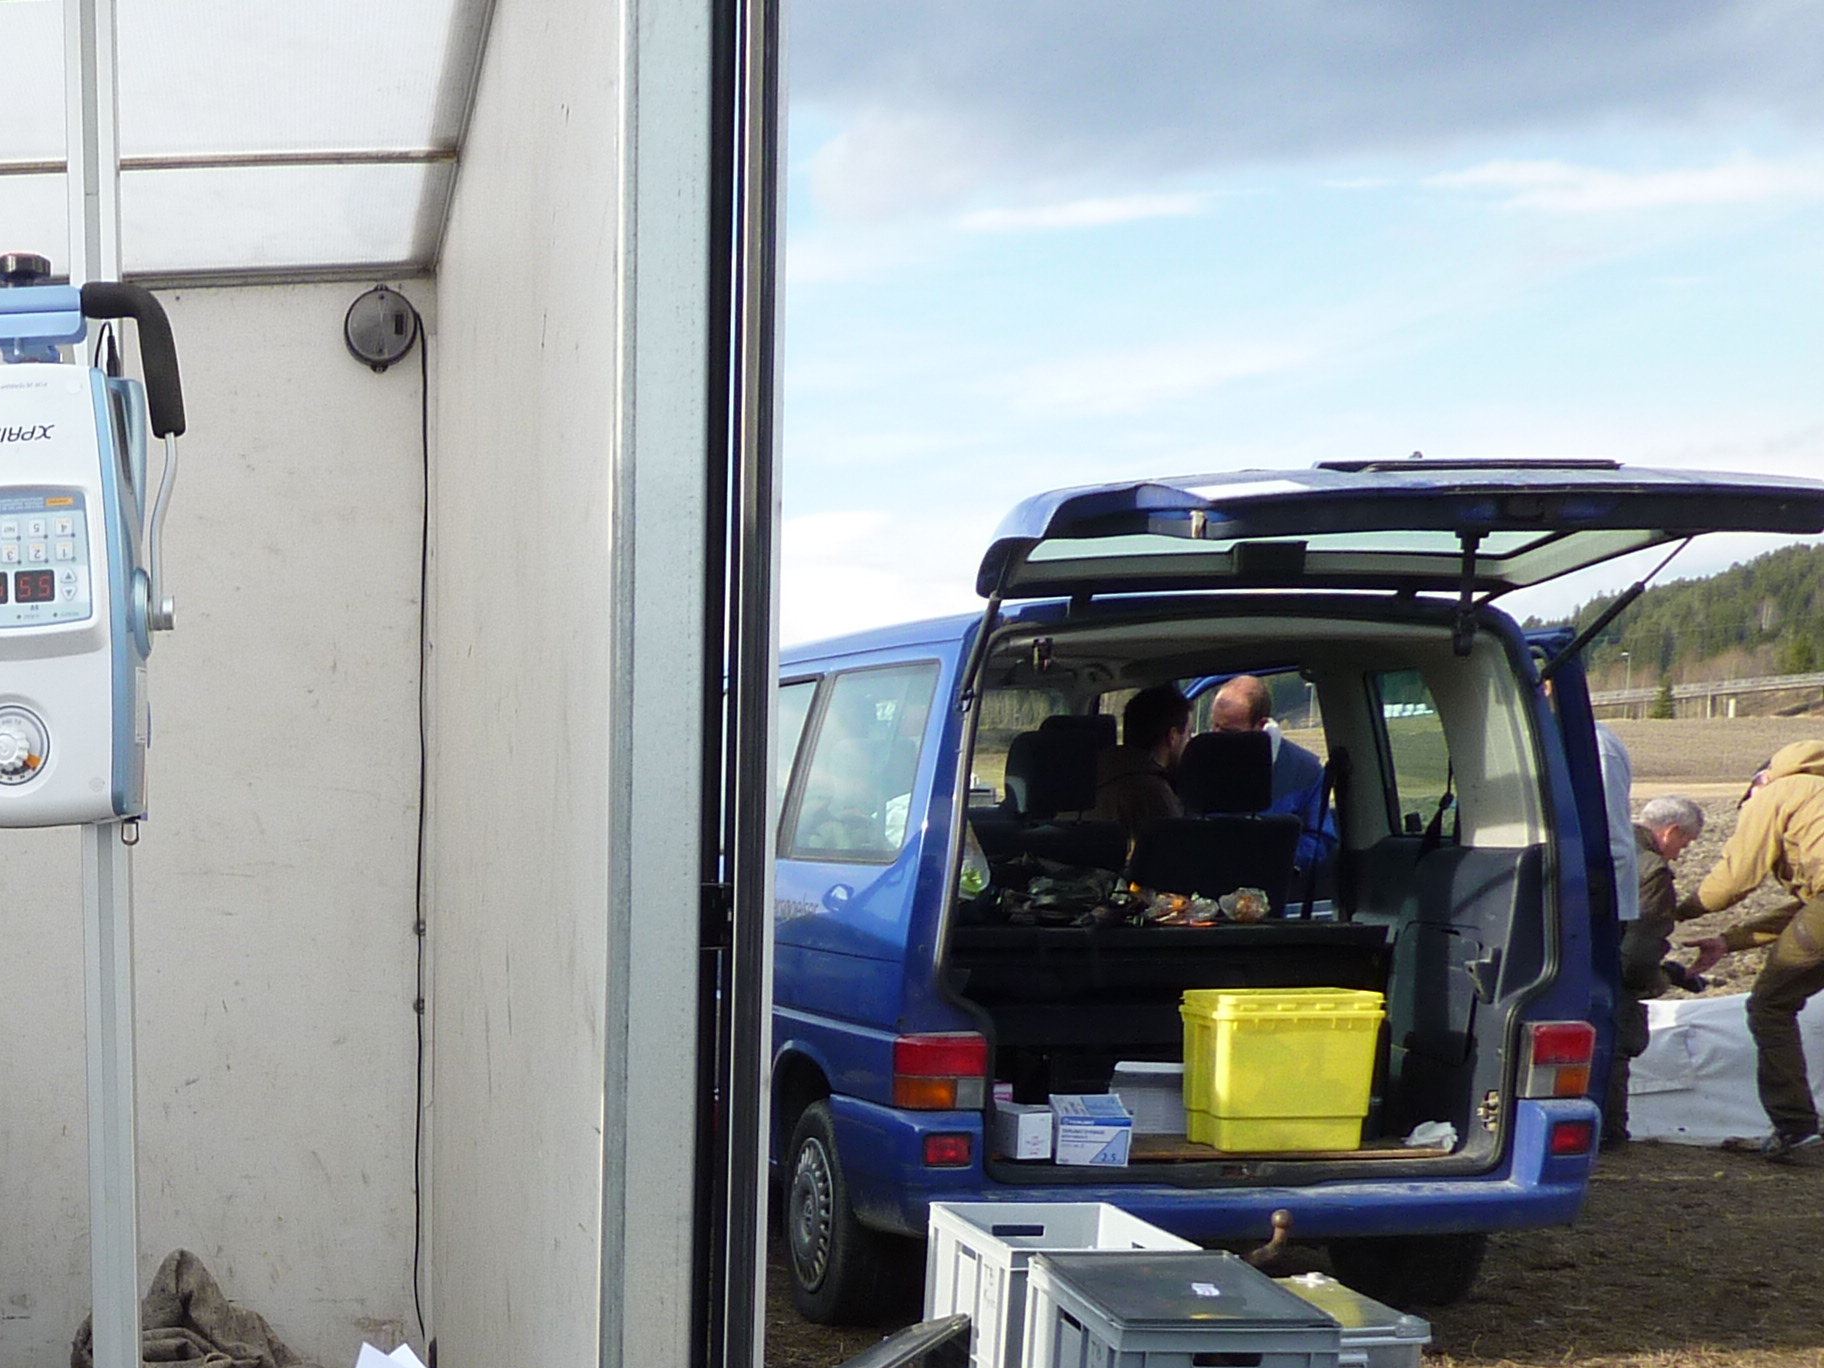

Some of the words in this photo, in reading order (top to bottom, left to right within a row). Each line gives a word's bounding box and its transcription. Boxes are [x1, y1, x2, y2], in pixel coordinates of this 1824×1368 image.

[33, 523, 40, 533] 5
[60, 523, 67, 533] 4
[6, 550, 14, 560] 3
[33, 549, 41, 559] 2
[19, 575, 52, 598] 55
